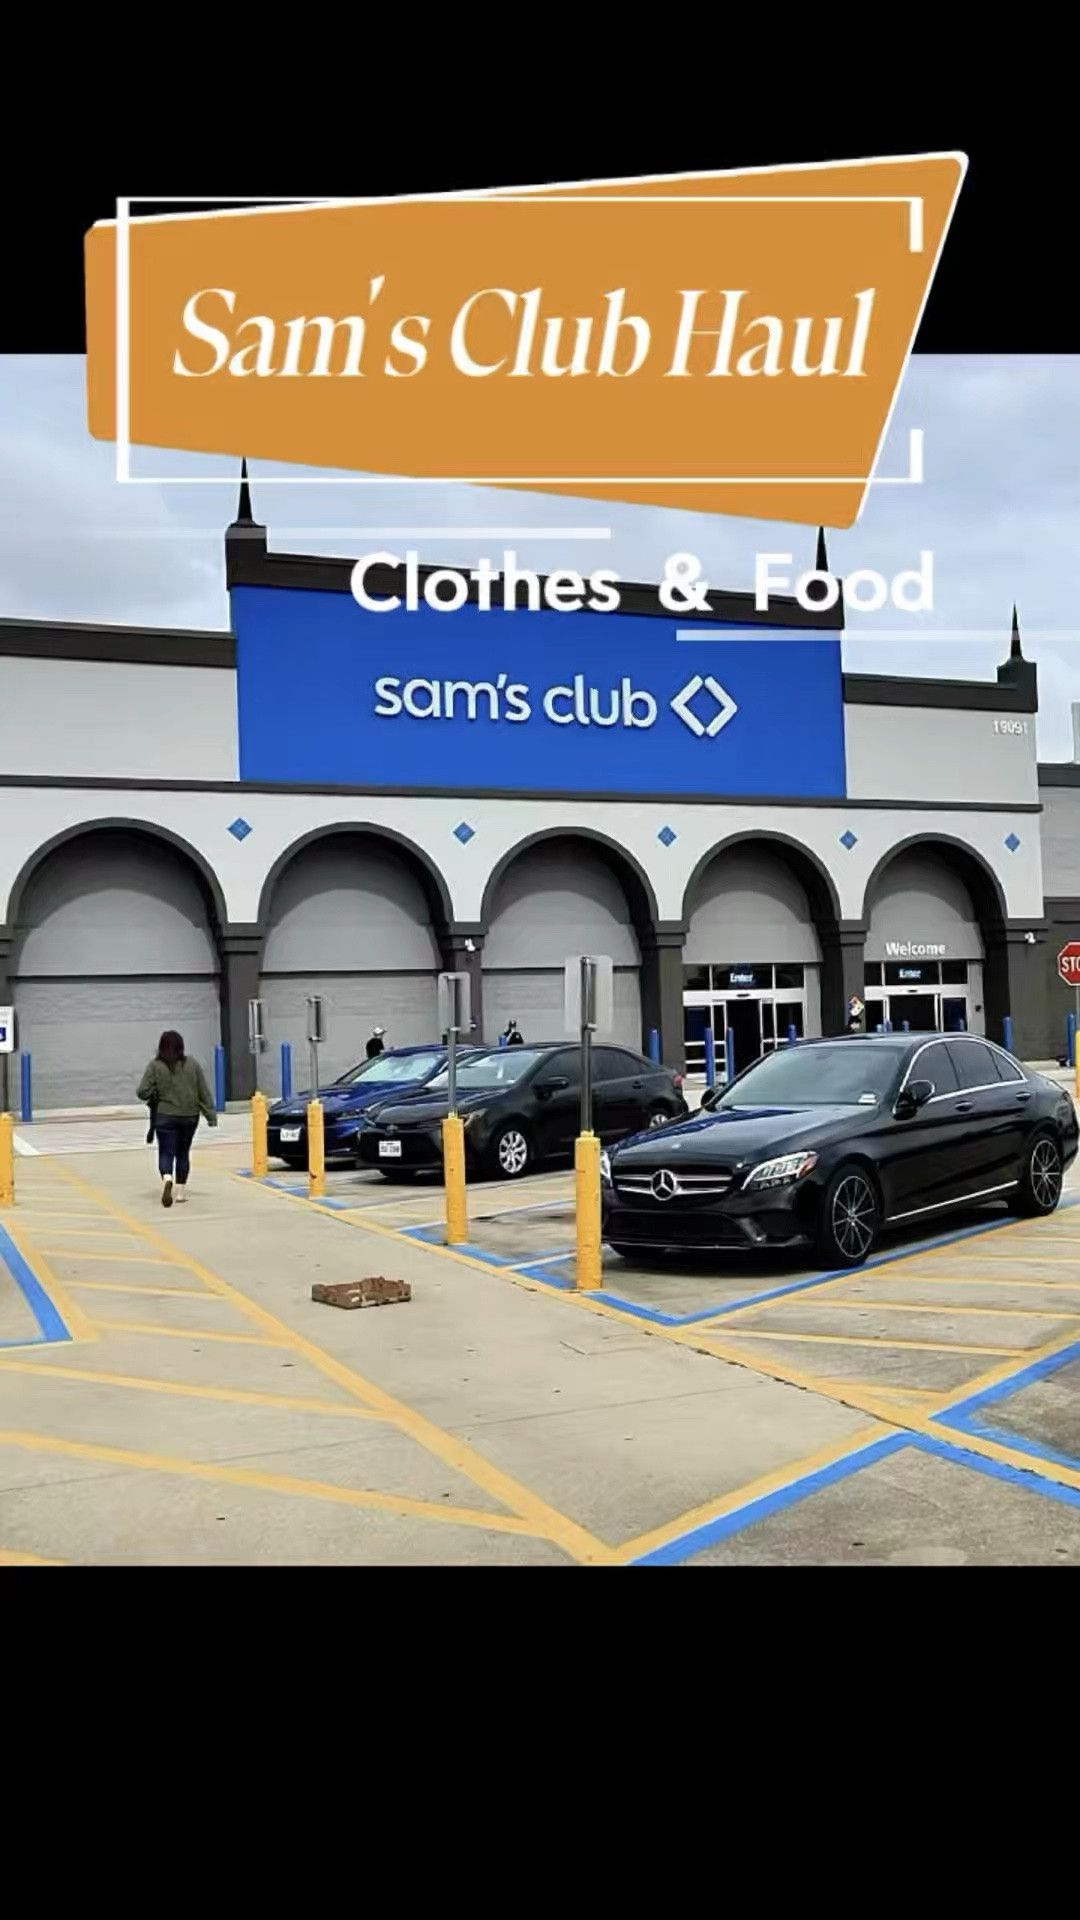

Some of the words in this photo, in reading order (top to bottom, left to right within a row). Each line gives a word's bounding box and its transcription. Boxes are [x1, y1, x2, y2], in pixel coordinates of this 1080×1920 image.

[374, 673, 531, 721] sam's
[543, 675, 658, 728] club
[885, 941, 946, 957] Welcome
[729, 972, 754, 983] Enter
[898, 968, 922, 979] Enter
